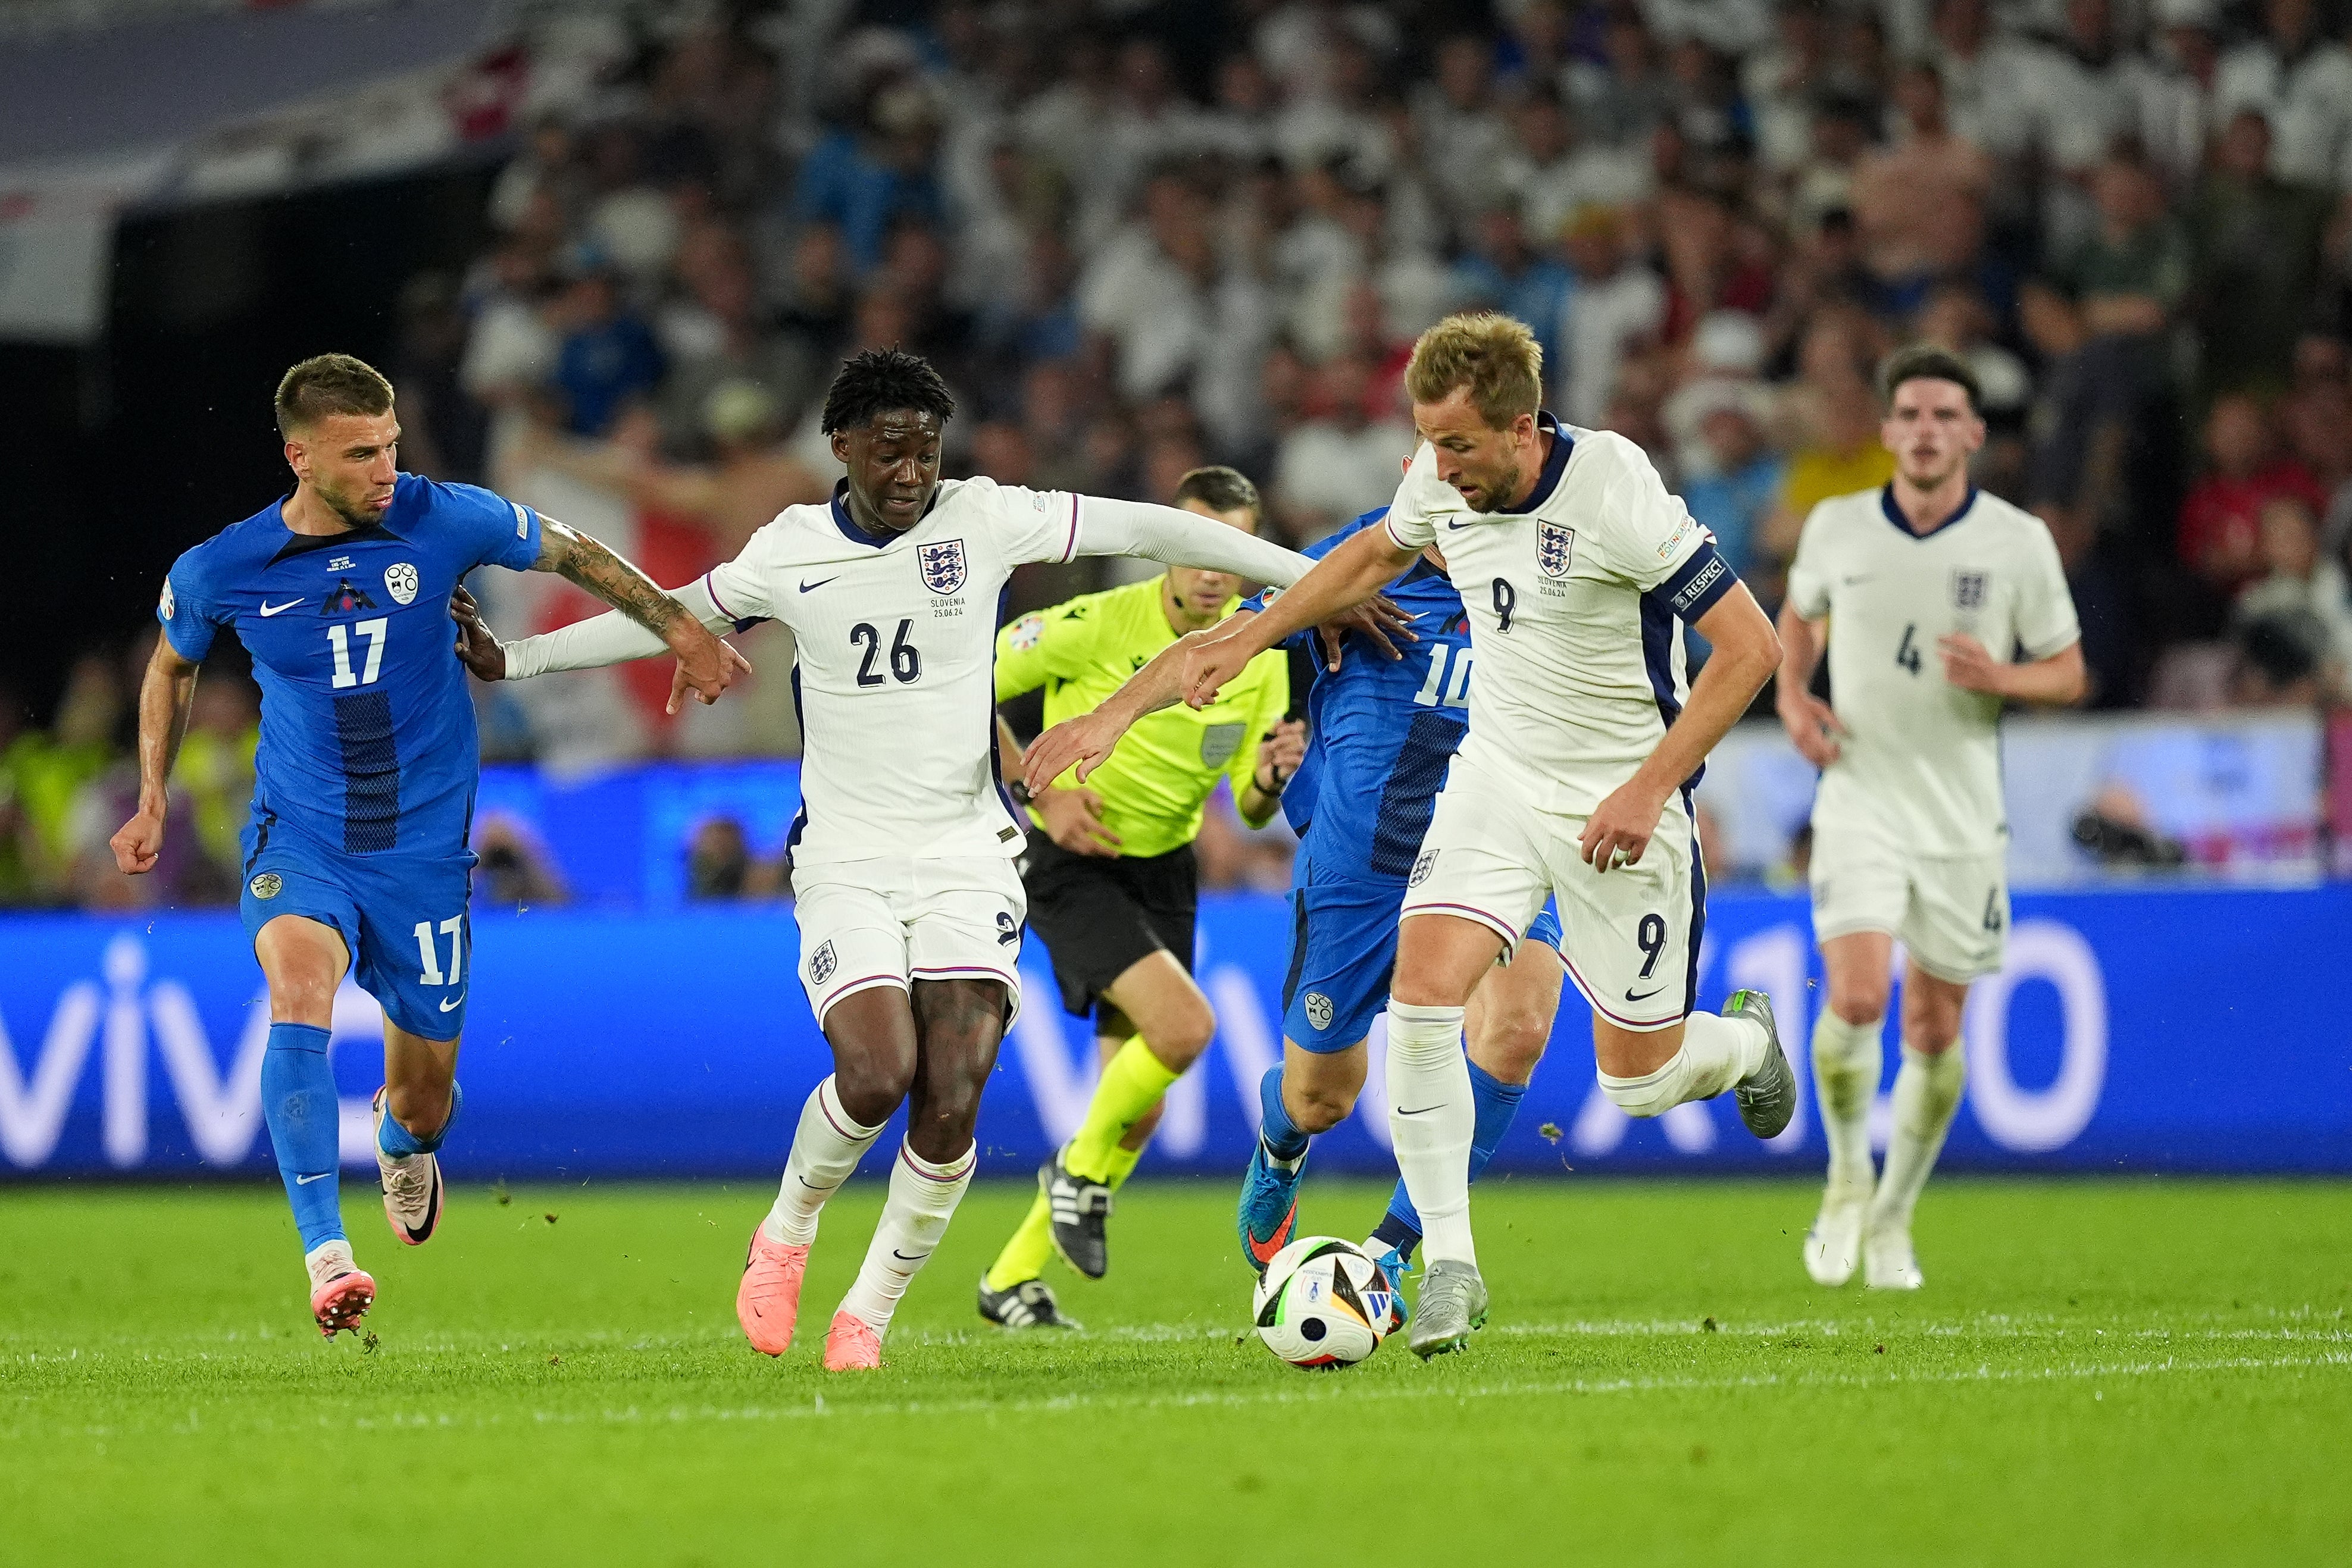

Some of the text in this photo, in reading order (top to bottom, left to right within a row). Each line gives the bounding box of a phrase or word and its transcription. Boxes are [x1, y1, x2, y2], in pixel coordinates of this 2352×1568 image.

[1660, 514, 1689, 558] FOUNDATION
[930, 597, 965, 608] SLOVENIA
[1537, 575, 1567, 589] SLOVENIA
[1685, 559, 1724, 599] RESPECT
[934, 608, 962, 617] 25.06.24
[1492, 577, 1517, 634] 9
[326, 617, 388, 688] 17
[850, 619, 922, 688] 26
[1896, 623, 1922, 675] 4
[1982, 886, 2002, 935] 4
[412, 913, 462, 985] 17
[1638, 913, 1668, 979] 9
